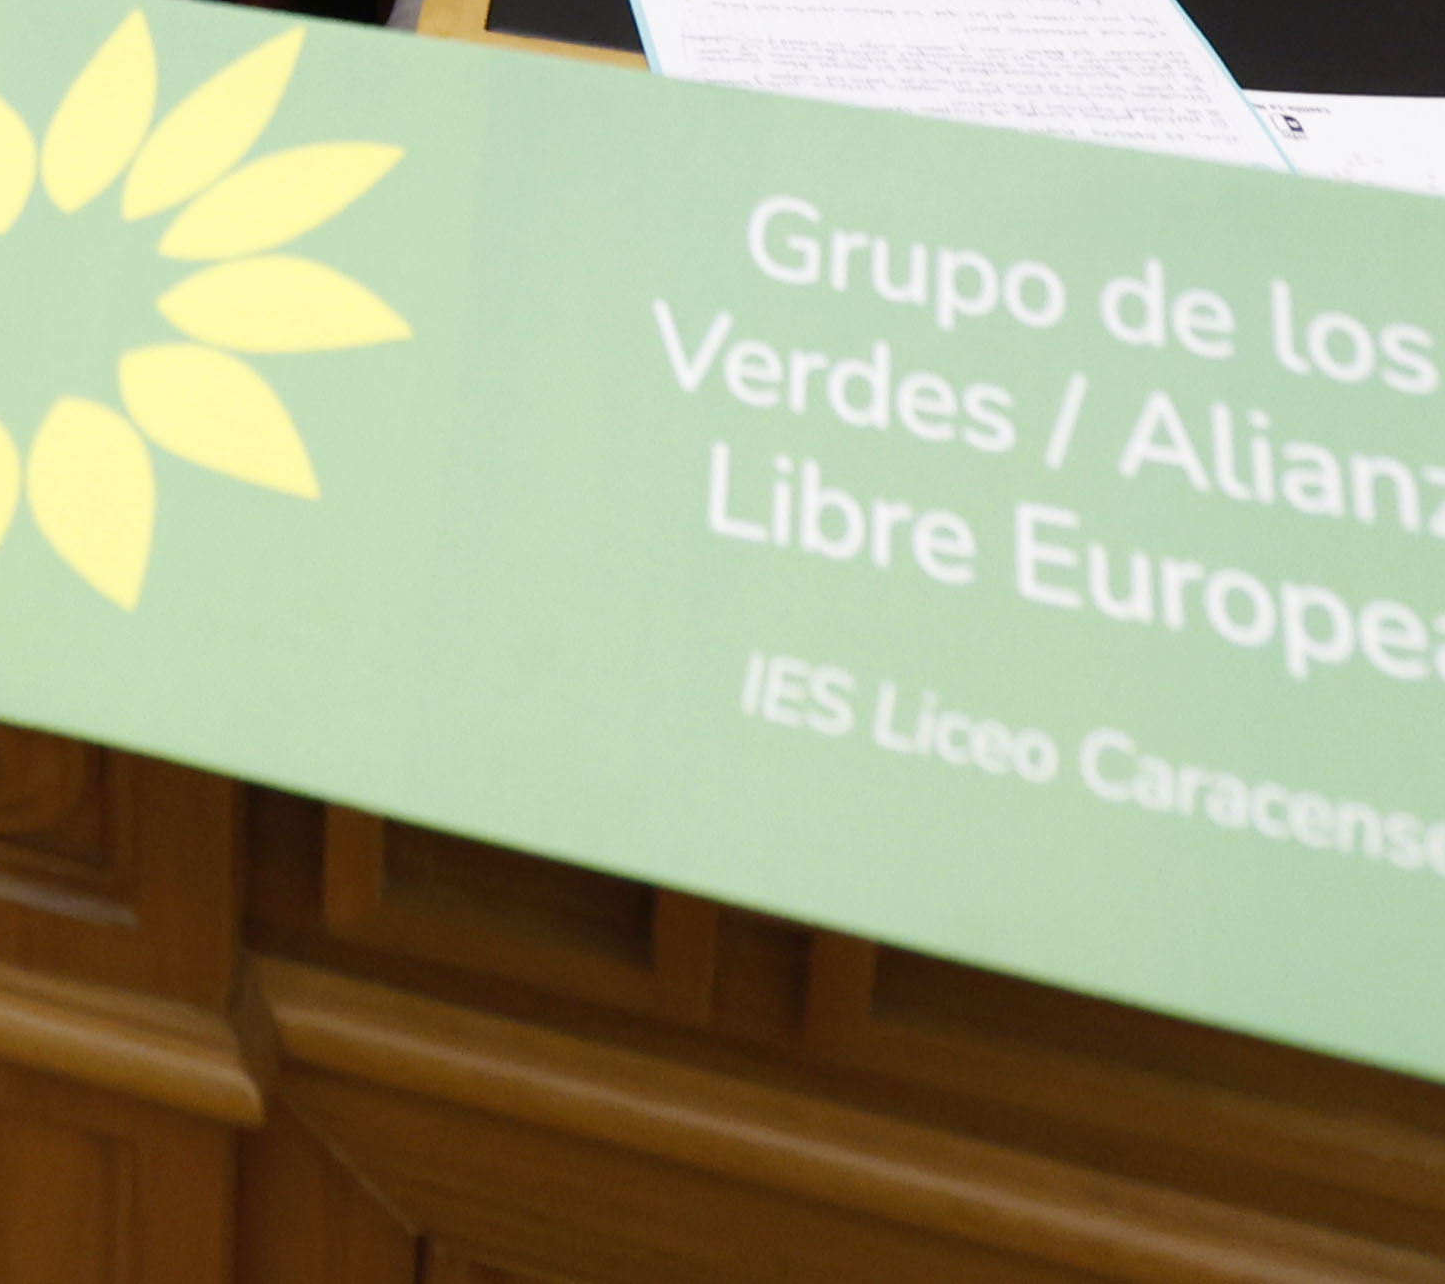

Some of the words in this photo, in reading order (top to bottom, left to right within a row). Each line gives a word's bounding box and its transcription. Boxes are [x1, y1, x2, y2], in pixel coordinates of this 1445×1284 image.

[746, 194, 1068, 333] Grupo
[1098, 257, 1236, 361] de
[1270, 277, 1441, 396] los
[652, 298, 1018, 454] Verdes
[1044, 371, 1090, 470] /
[706, 439, 977, 585] Libre
[740, 650, 856, 737] IES
[871, 681, 1060, 784] Liceo
